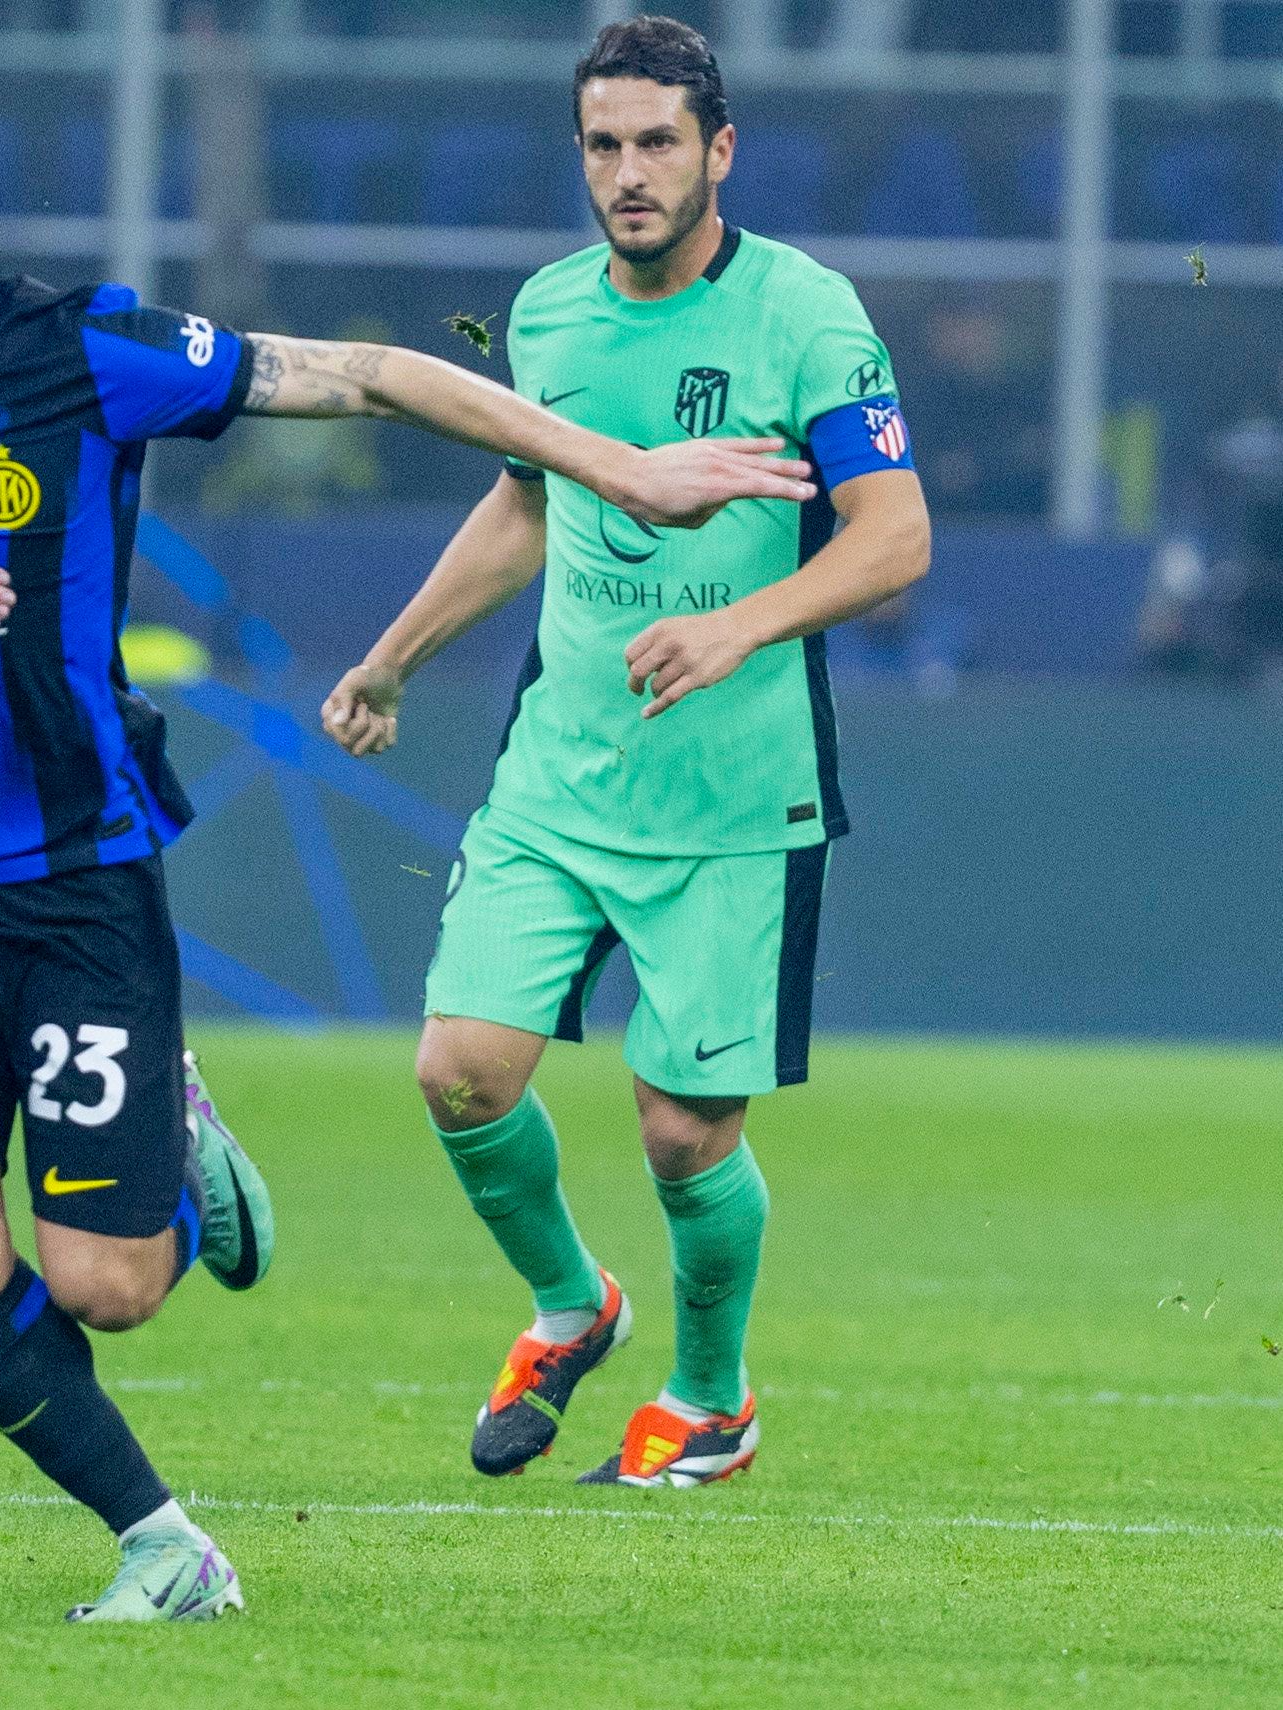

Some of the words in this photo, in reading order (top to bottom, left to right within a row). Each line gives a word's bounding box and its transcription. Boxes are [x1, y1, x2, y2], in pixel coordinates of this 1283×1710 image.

[179, 312, 215, 368] eb
[566, 569, 663, 610] RIYADH
[674, 582, 733, 610] AIR
[27, 1022, 130, 1128] 23
